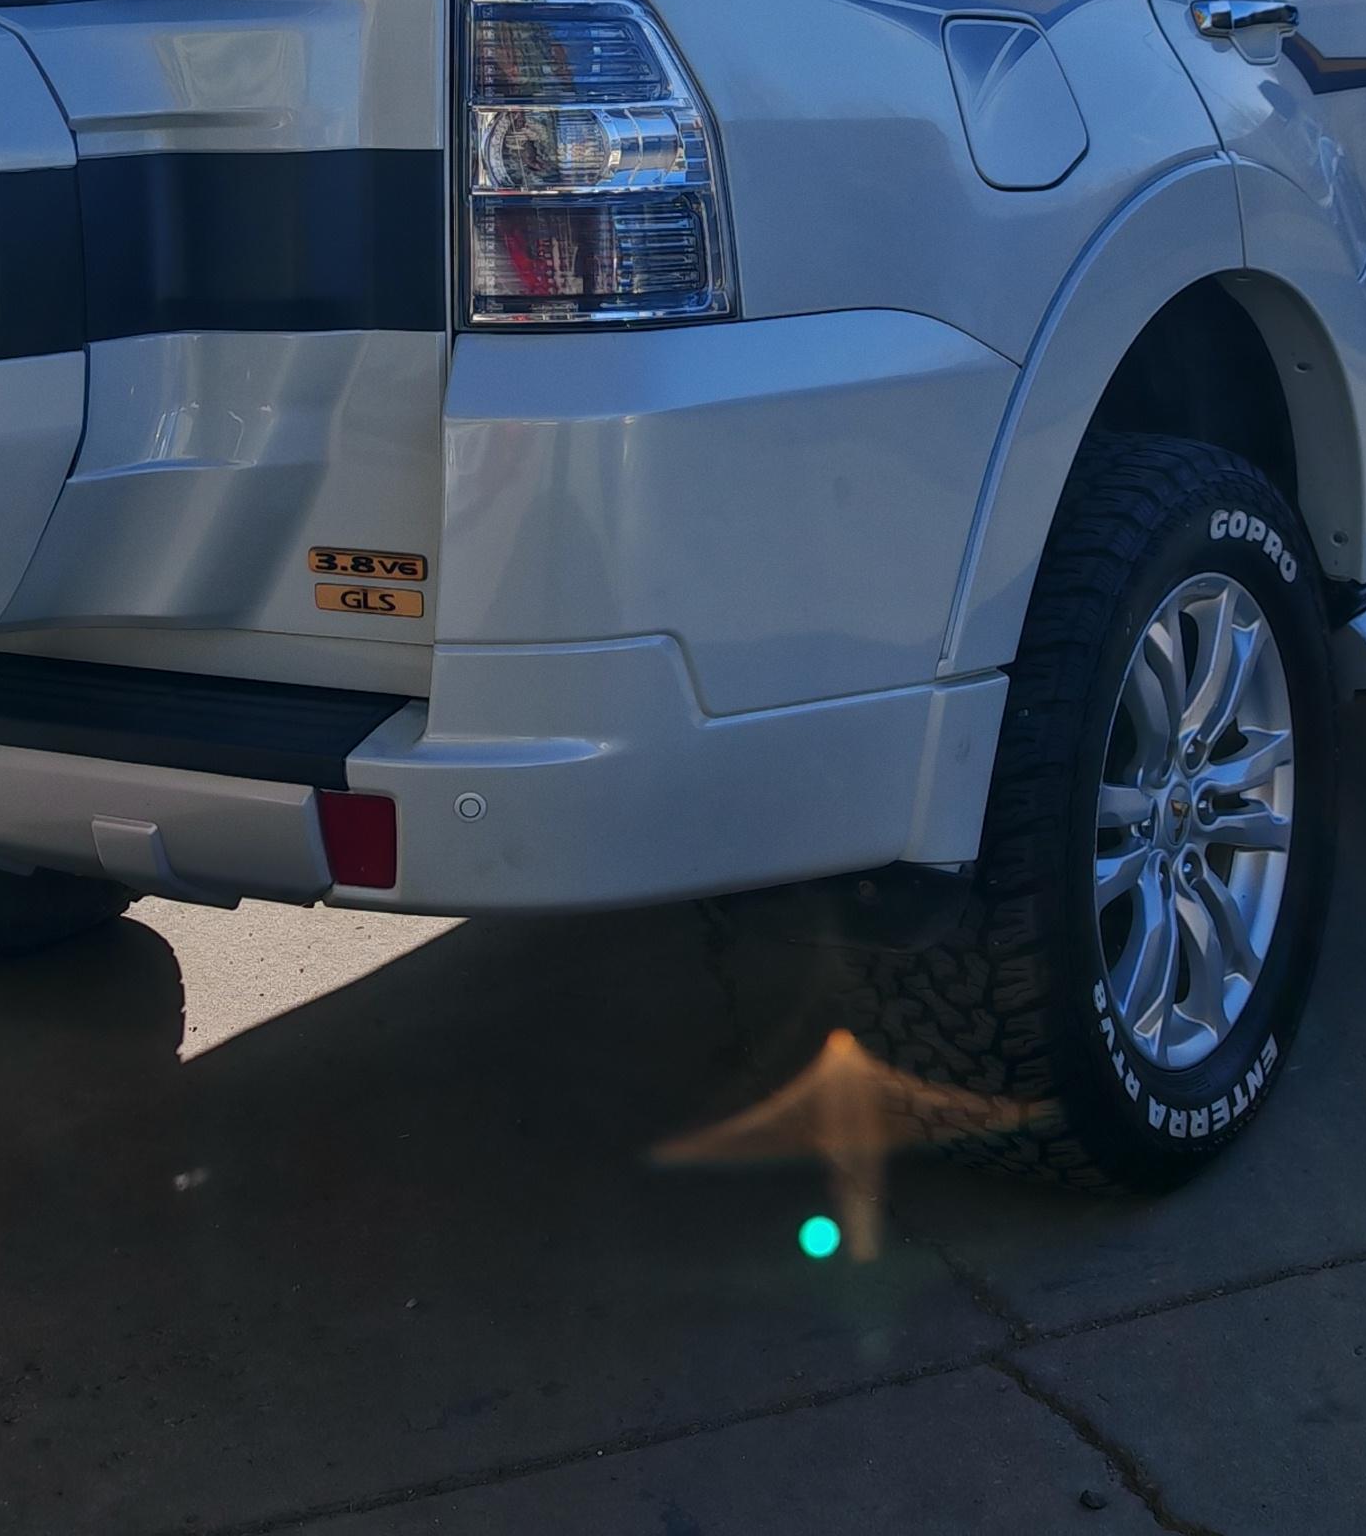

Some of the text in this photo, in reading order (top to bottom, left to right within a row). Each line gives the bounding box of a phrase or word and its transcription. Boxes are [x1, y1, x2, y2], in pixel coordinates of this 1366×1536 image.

[1210, 509, 1297, 583] GOPRO
[340, 589, 396, 612] GLS
[1147, 1032, 1279, 1139] ENTERRA
